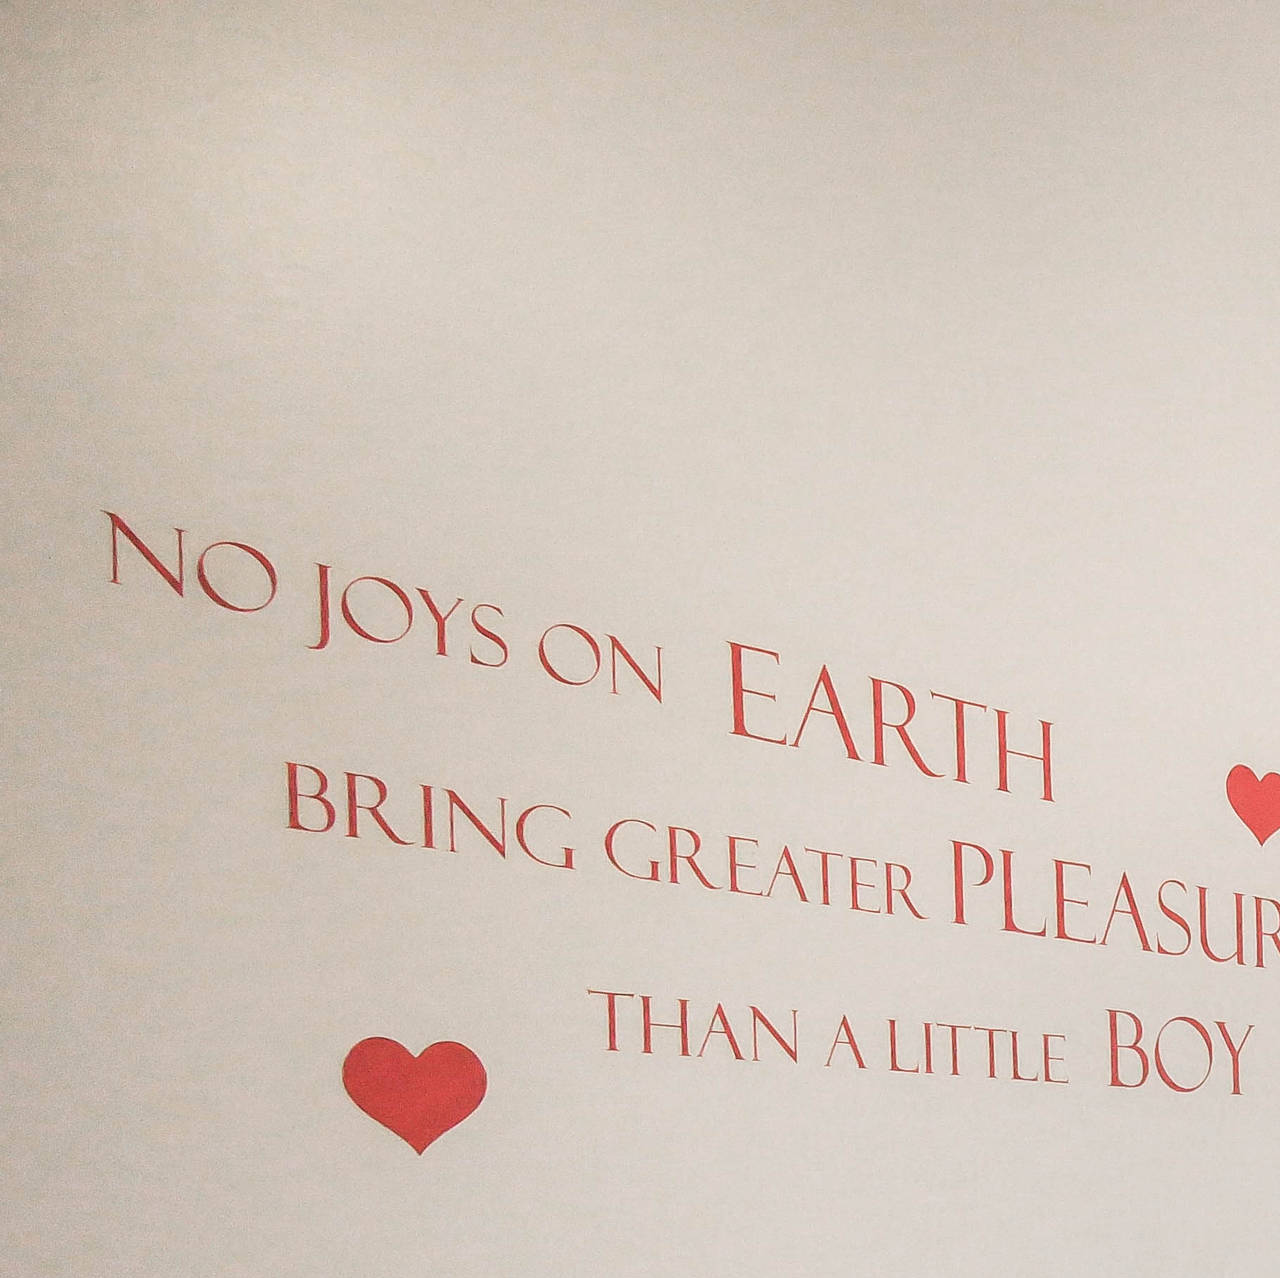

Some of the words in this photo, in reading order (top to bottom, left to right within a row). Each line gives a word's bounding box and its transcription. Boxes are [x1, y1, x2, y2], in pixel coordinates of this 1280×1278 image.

[104, 511, 278, 614] NO
[308, 562, 509, 669] JOYS
[536, 623, 664, 704] ON
[728, 641, 1056, 802] EARTH
[284, 761, 577, 871] BRING
[604, 819, 929, 921] GREATER
[587, 988, 799, 1063] THAN
[825, 1015, 867, 1070] A
[887, 1018, 1069, 1085] LITTLE
[1107, 1008, 1255, 1097] BOY
